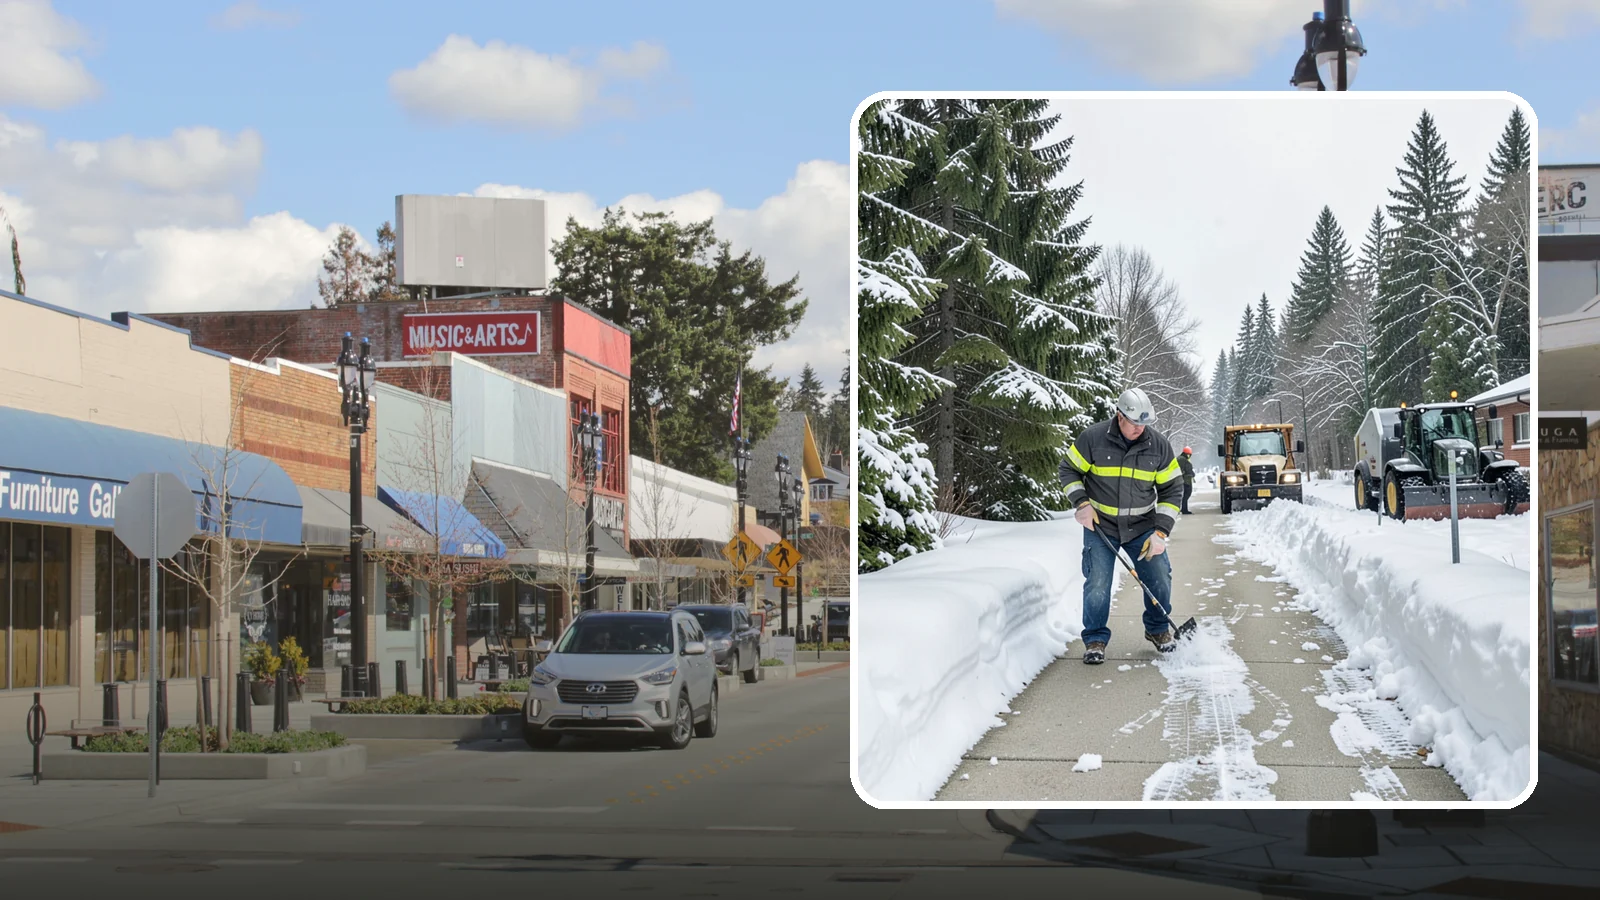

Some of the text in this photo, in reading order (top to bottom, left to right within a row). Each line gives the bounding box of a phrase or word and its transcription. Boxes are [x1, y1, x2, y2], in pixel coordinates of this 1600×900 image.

[1540, 427, 1578, 437] UGA
[0, 471, 122, 519] Furniture Gal
[453, 563, 480, 574] SUSHI
